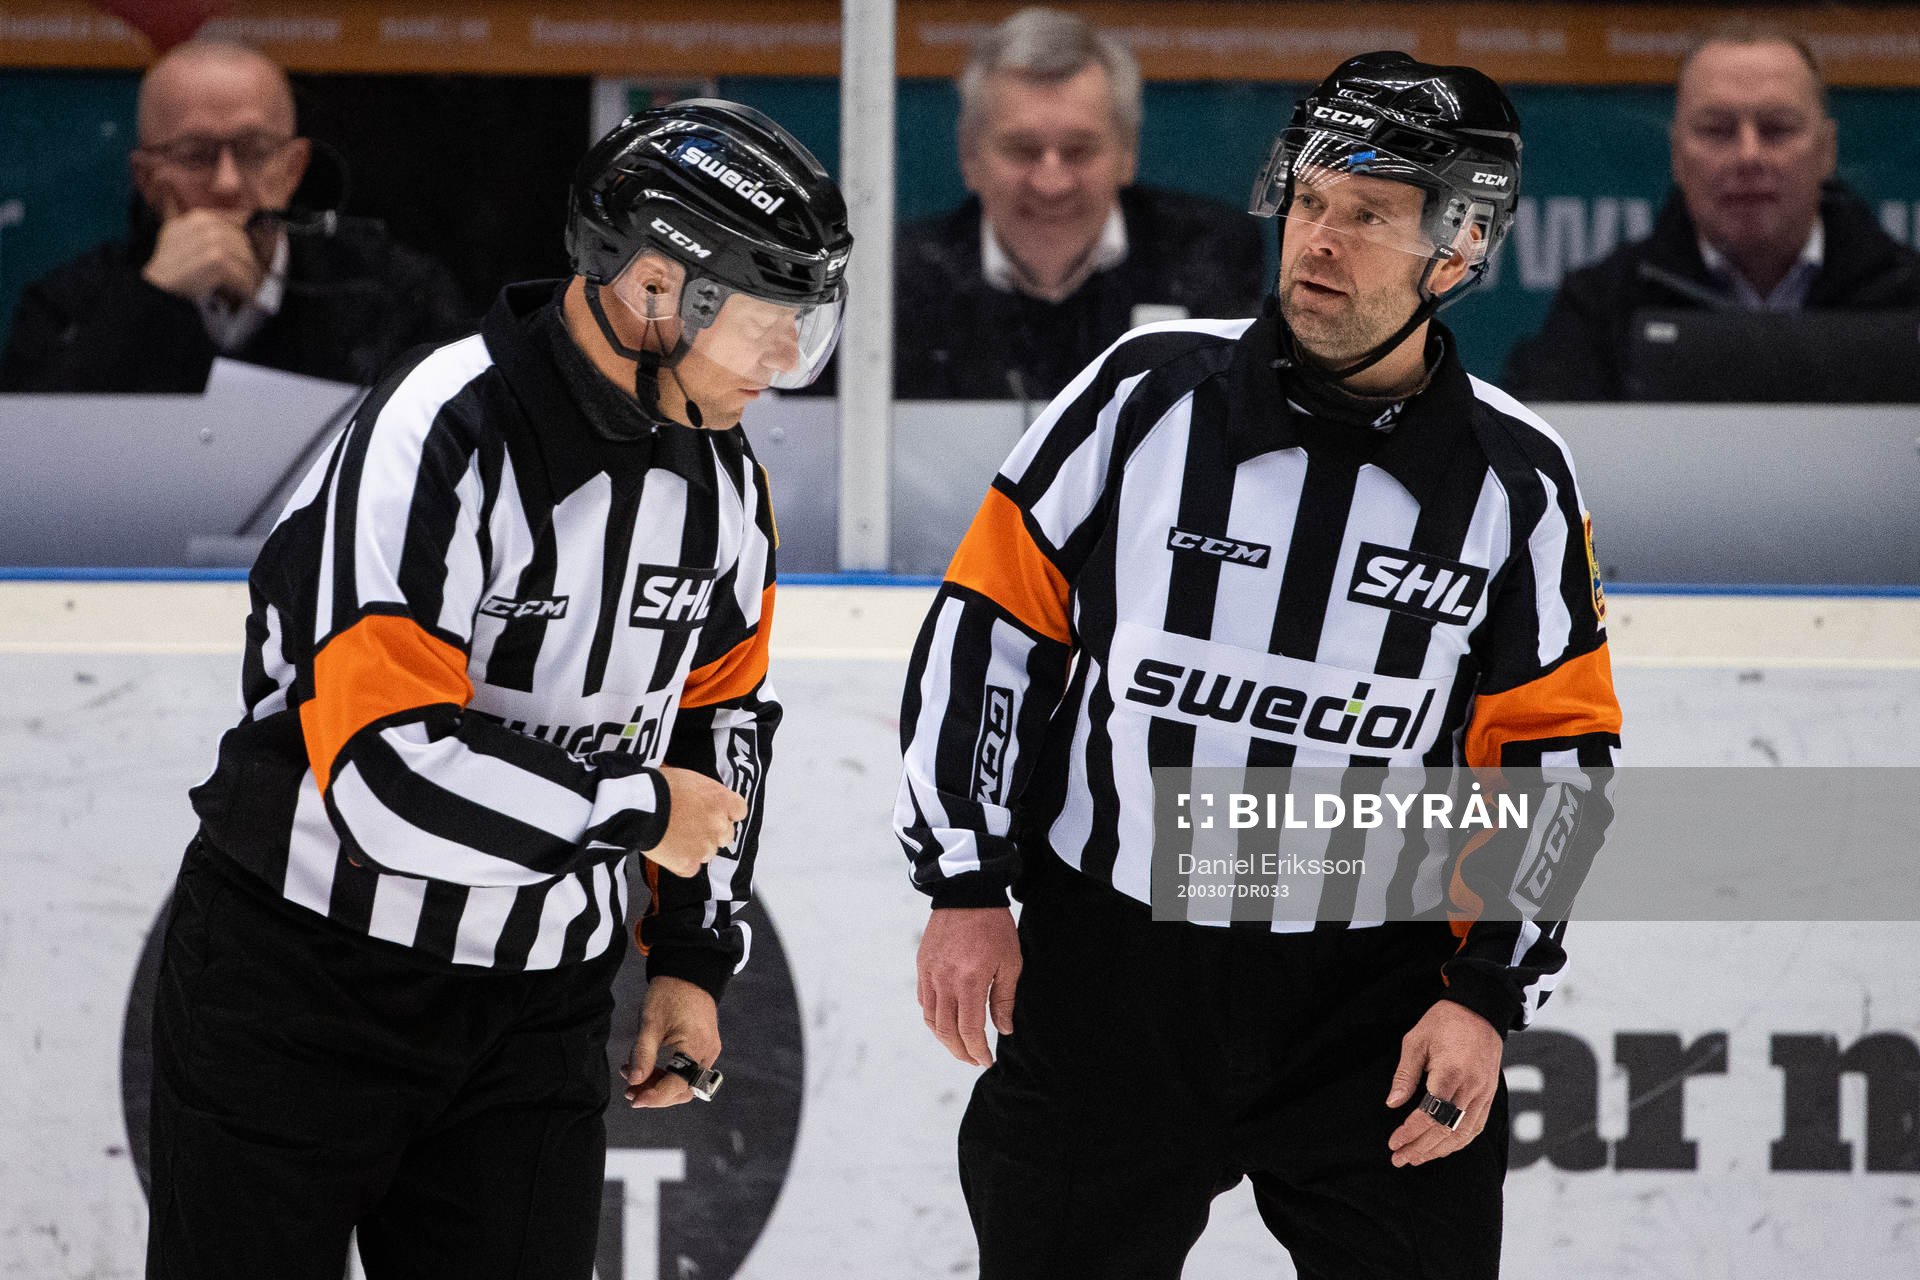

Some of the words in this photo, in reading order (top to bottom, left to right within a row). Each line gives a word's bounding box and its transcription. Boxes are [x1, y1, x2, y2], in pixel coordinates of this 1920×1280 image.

[1313, 106, 1375, 130] CCM
[680, 146, 785, 216] swedol
[1471, 171, 1509, 188] CCM
[651, 217, 712, 259] CCM
[1170, 530, 1267, 564] CCM
[481, 598, 567, 618] CCM
[1354, 555, 1474, 616] SHL
[1126, 658, 1437, 751] swedol
[977, 690, 1009, 805] CCM
[1523, 785, 1579, 899] CCM
